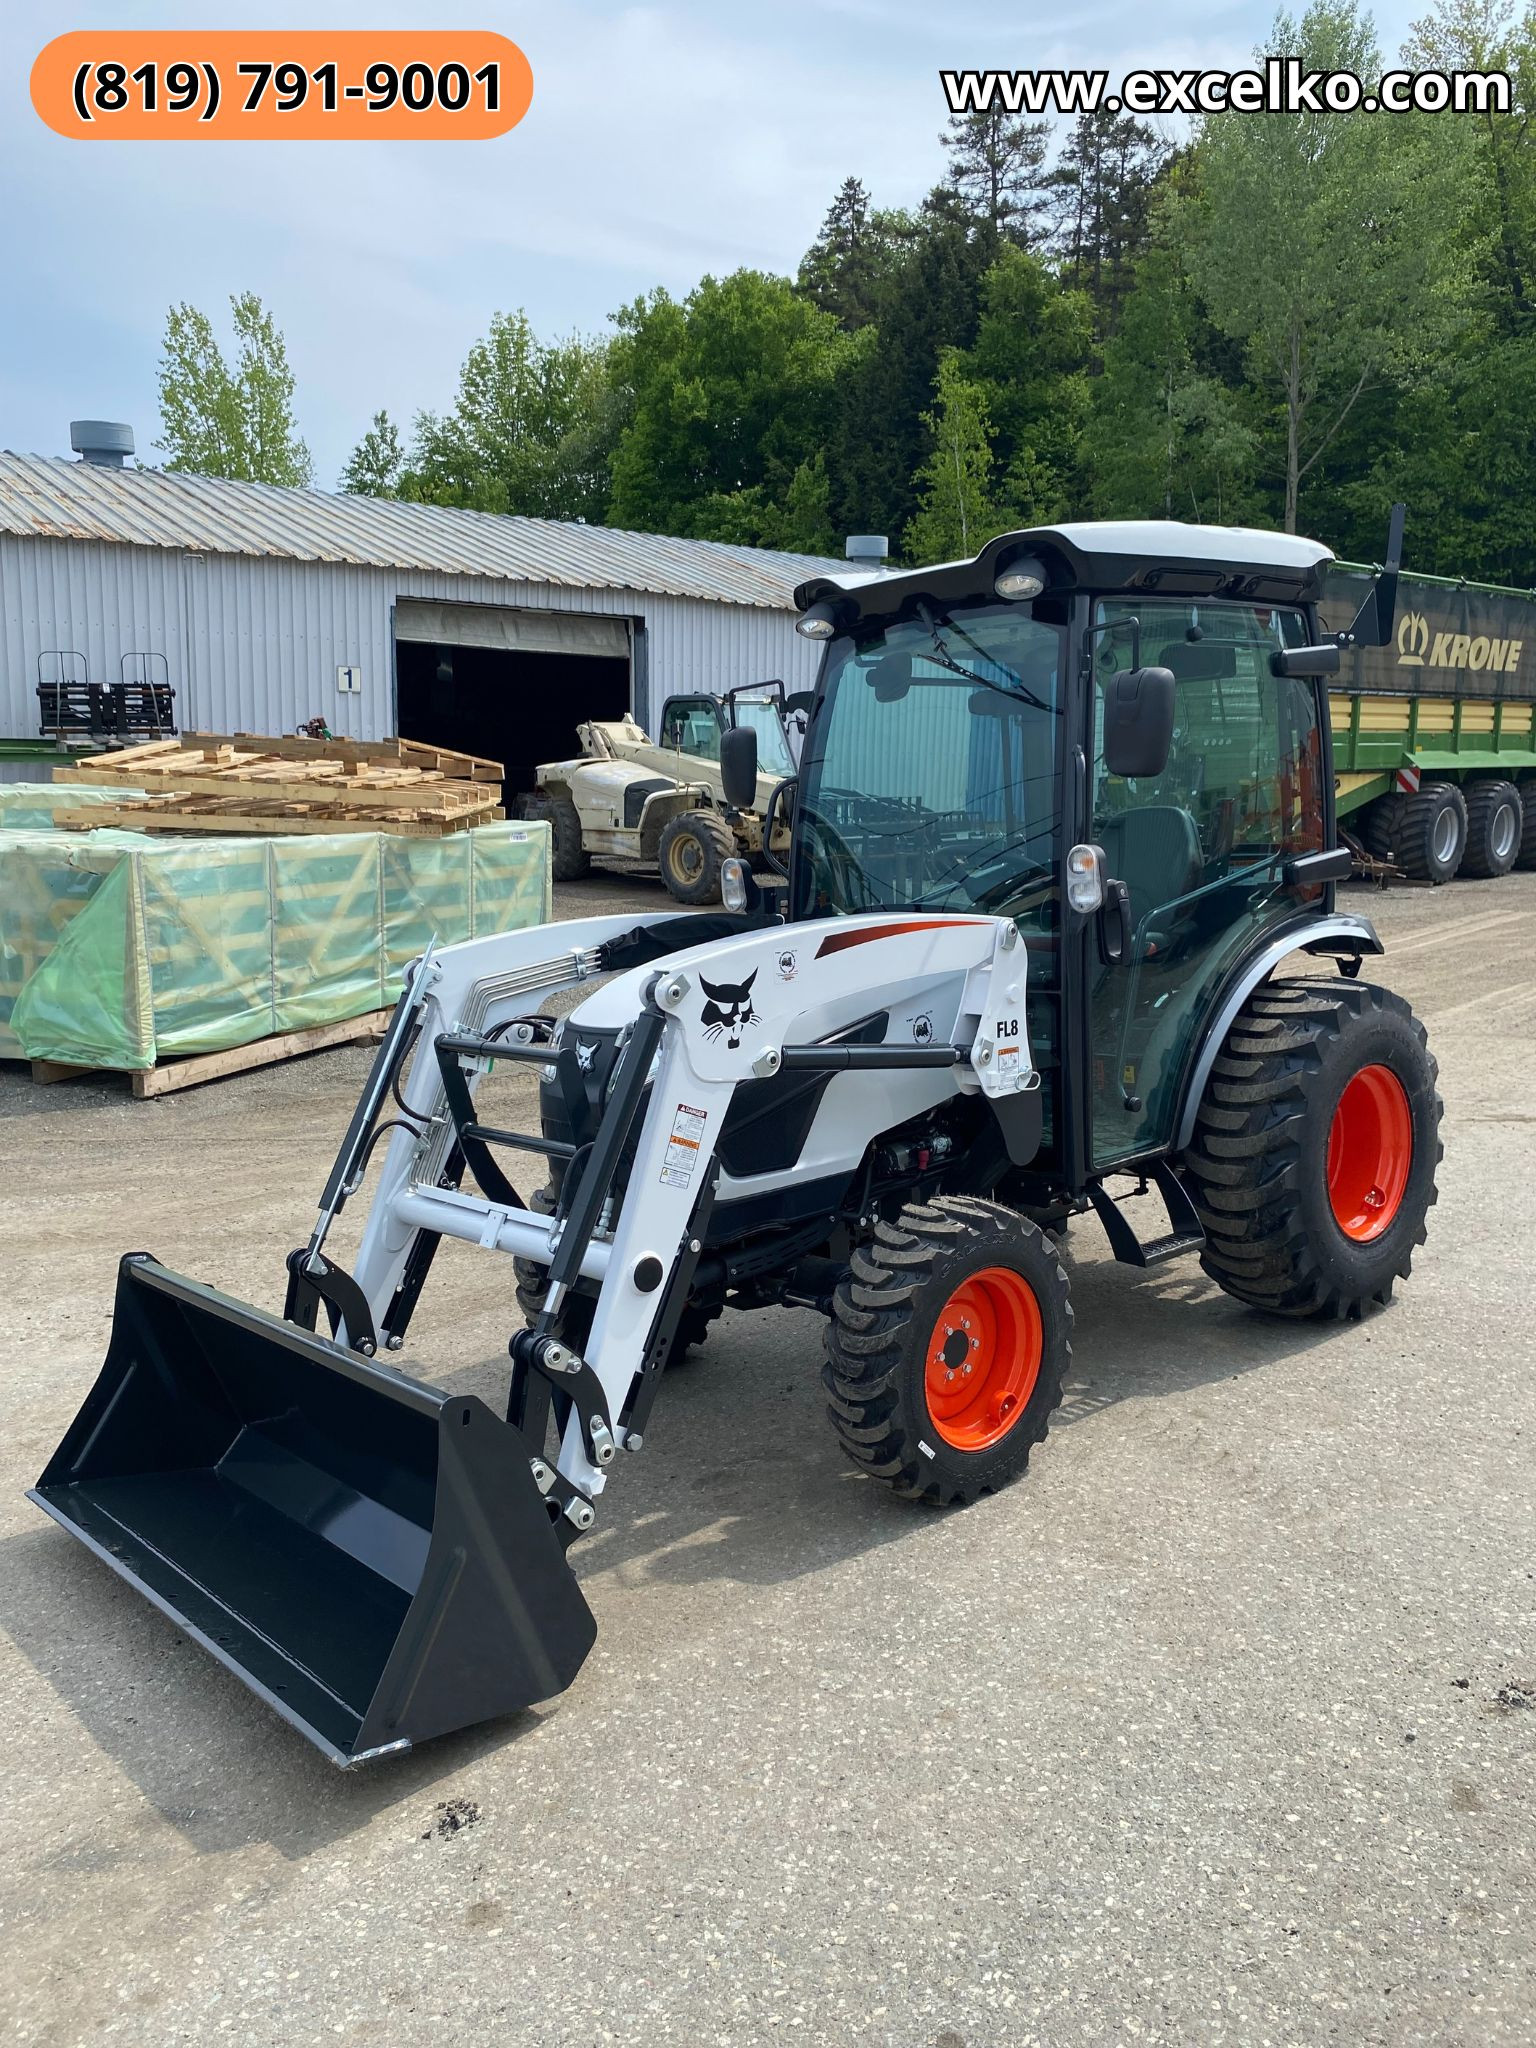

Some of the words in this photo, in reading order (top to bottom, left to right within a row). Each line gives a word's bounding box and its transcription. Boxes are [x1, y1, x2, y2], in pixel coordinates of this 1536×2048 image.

[1428, 632, 1523, 672] KRONE
[343, 669, 353, 689] 1
[997, 1019, 1019, 1038] FL8
[685, 1107, 705, 1117] DANGER
